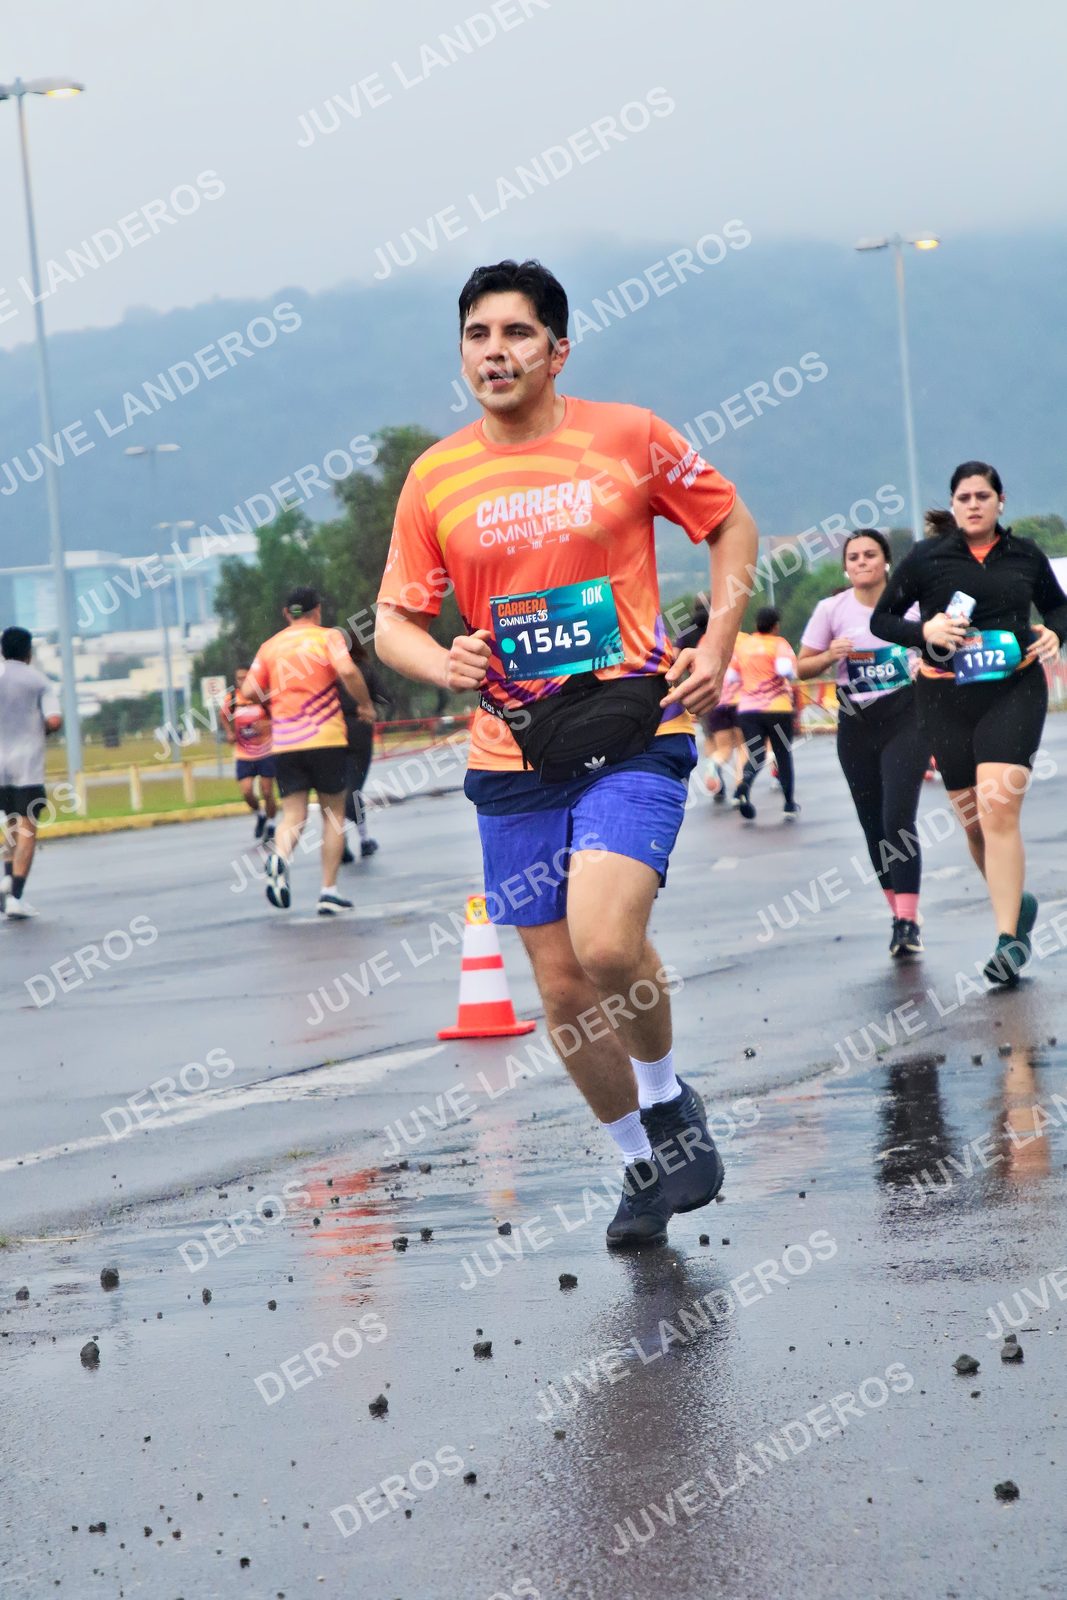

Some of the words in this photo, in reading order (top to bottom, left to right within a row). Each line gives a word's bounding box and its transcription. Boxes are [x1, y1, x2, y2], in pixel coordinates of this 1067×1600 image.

[476, 480, 593, 528] CARRERA
[581, 585, 604, 606] 10K
[498, 598, 548, 617] CARRERA
[517, 620, 591, 655] 1545
[964, 650, 1006, 668] 1172
[858, 663, 896, 678] 1650
